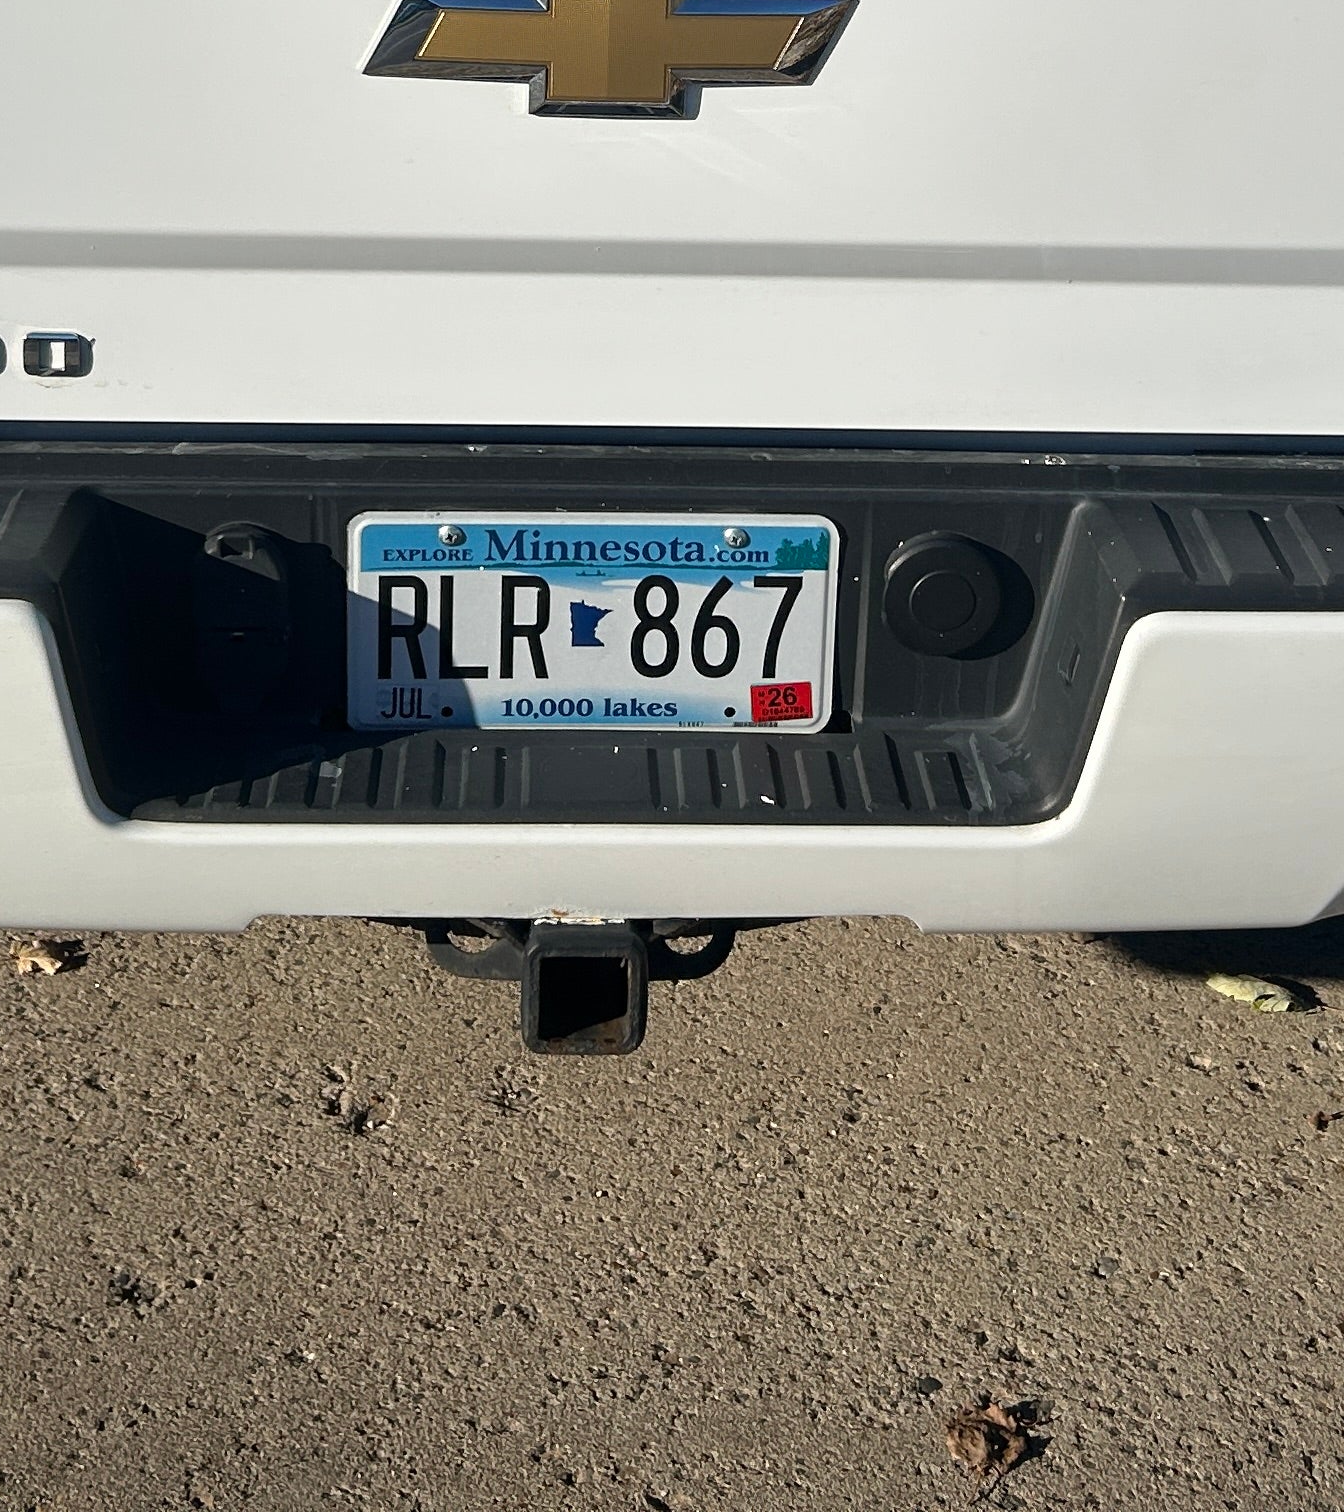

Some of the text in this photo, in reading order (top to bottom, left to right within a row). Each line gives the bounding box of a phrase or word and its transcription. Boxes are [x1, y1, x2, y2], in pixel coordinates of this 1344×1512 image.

[383, 548, 474, 562] EXPLORE
[377, 575, 804, 680] RLR 867
[380, 687, 432, 719] JUL
[767, 686, 798, 707] 26
[501, 697, 678, 719] 10,000 lakes
